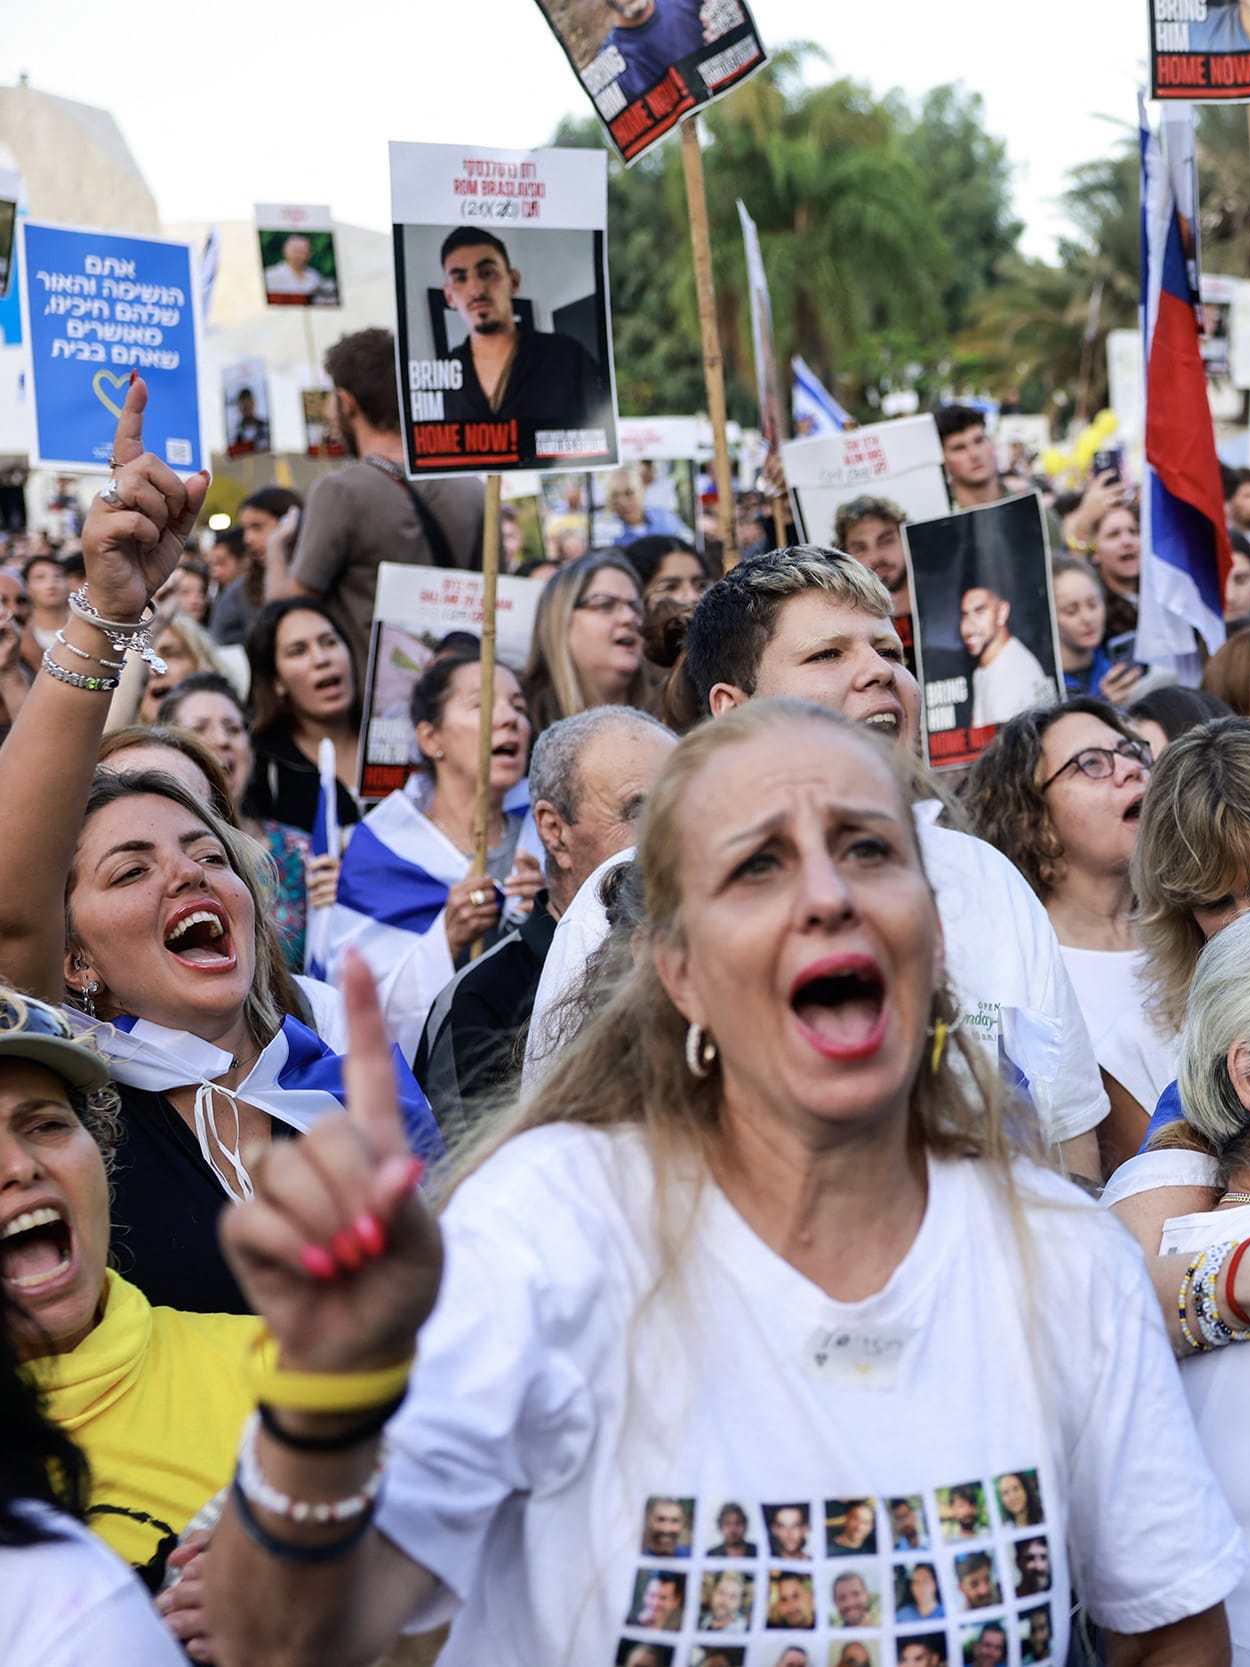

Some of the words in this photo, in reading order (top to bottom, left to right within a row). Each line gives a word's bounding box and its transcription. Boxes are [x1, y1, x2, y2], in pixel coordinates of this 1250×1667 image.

[1155, 22, 1190, 52] HIM
[1157, 55, 1207, 85] HOME
[610, 99, 654, 150] HOME
[644, 65, 690, 120] NOW!
[454, 179, 478, 195] ROM
[84, 254, 137, 280] אתם
[35, 270, 97, 297] והאור
[101, 278, 185, 307] הנשימה
[114, 301, 181, 328] שלהם
[66, 317, 163, 347] מאושרים
[50, 338, 107, 363] בבית
[110, 344, 181, 371] שאתם
[409, 358, 464, 391] BRING
[411, 391, 445, 422] HIM
[413, 423, 462, 455] HOME
[464, 418, 519, 454] NOW!
[926, 675, 968, 709] BRING
[927, 704, 957, 733] HIM
[977, 1001, 1000, 1011] OPEN
